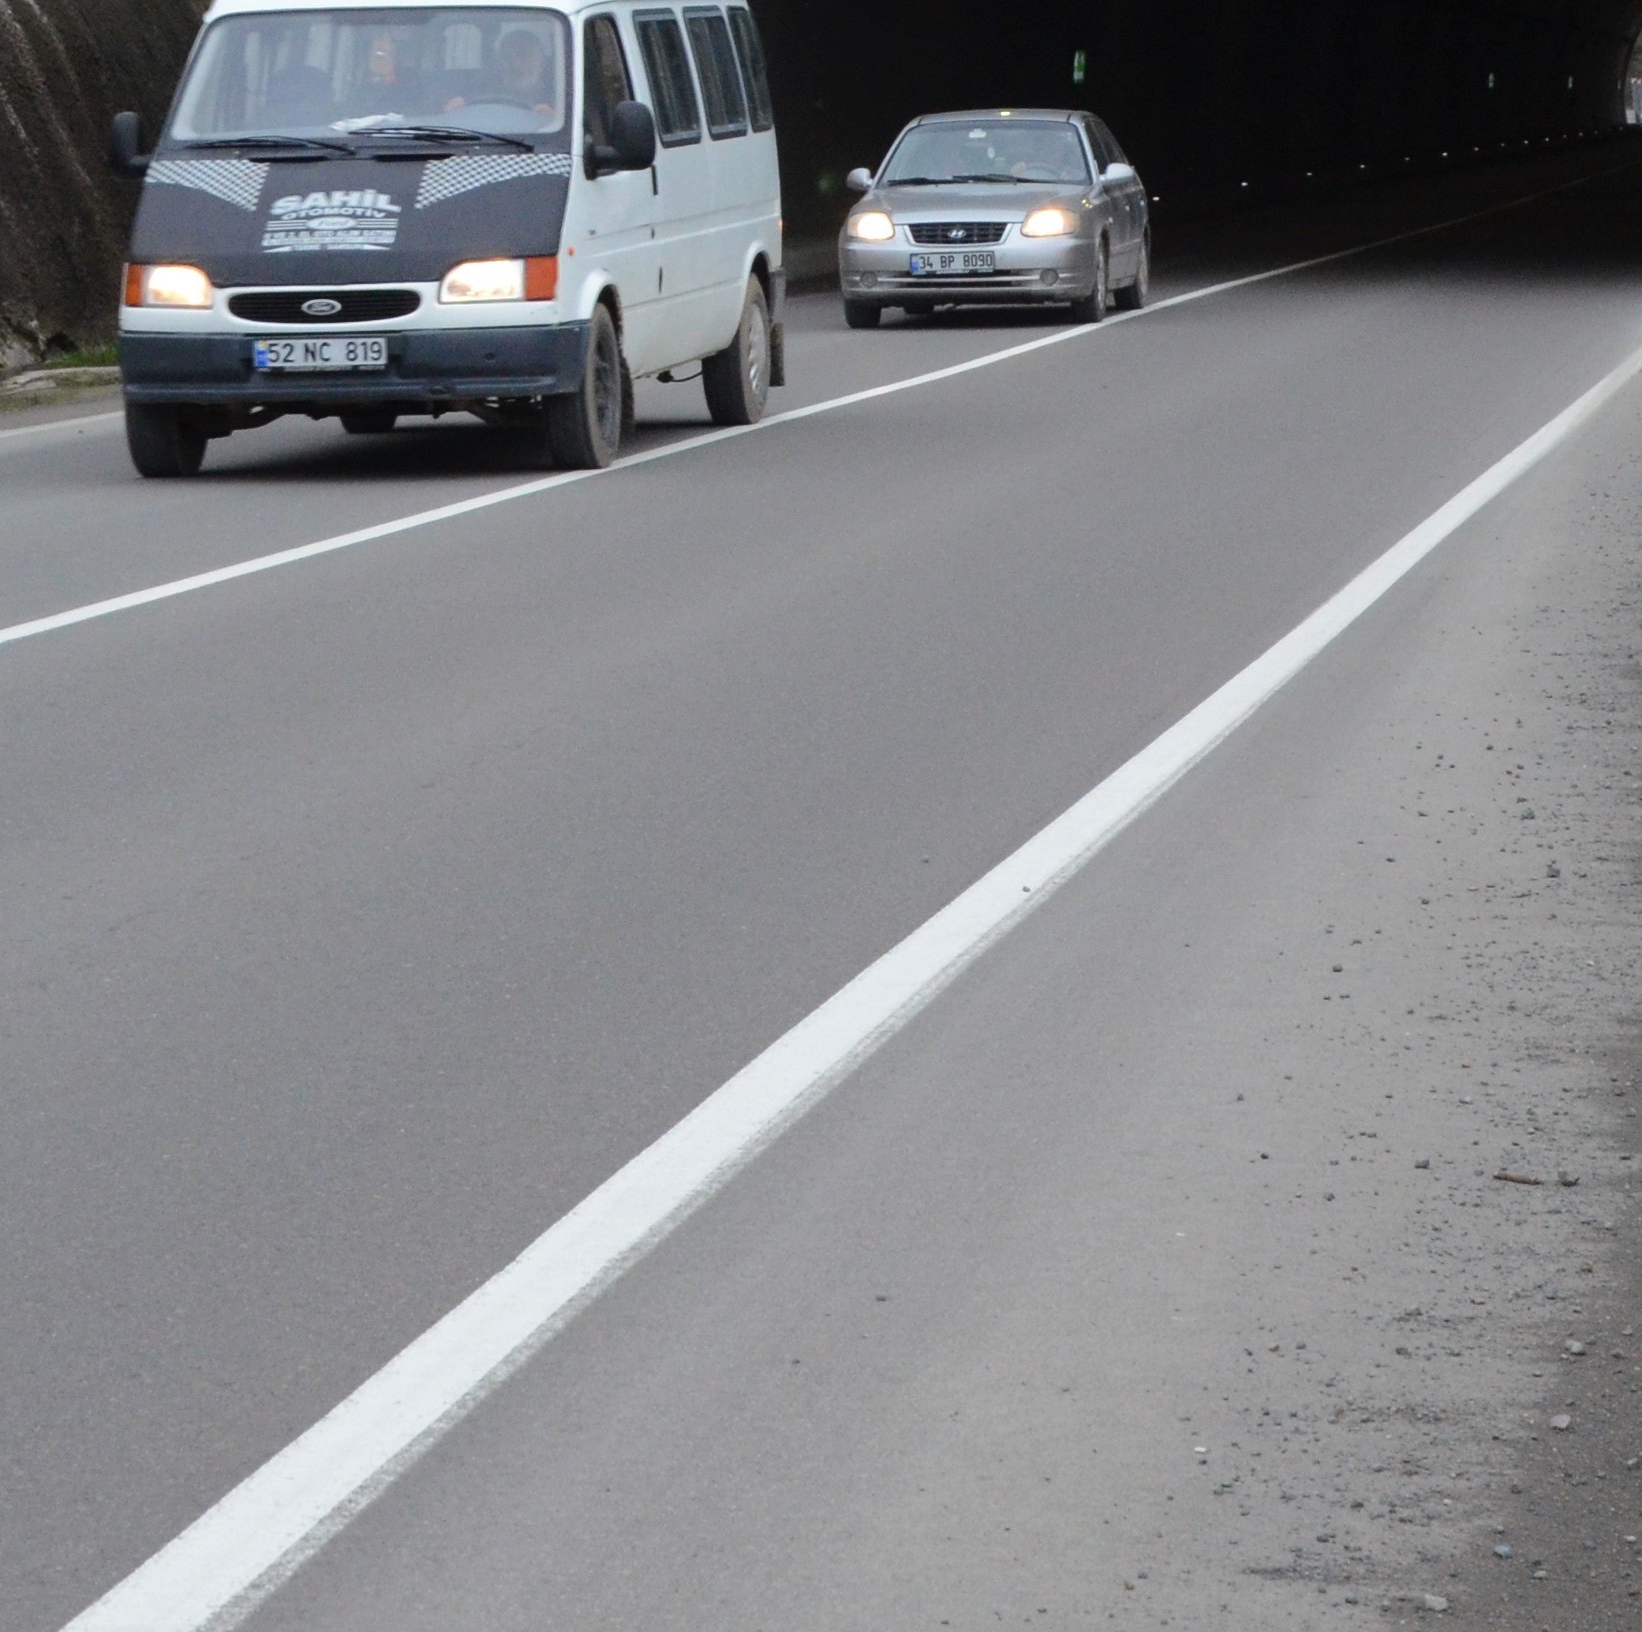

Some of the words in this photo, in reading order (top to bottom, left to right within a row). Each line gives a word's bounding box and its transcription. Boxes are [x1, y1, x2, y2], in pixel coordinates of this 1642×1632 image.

[270, 189, 402, 215] SAHİL
[280, 207, 386, 220] OTOMOTİV
[918, 255, 933, 269] 34
[940, 255, 955, 269] BP
[963, 253, 993, 267] 8090
[268, 342, 295, 363] 52
[304, 342, 331, 362] NC
[345, 341, 382, 362] 819
